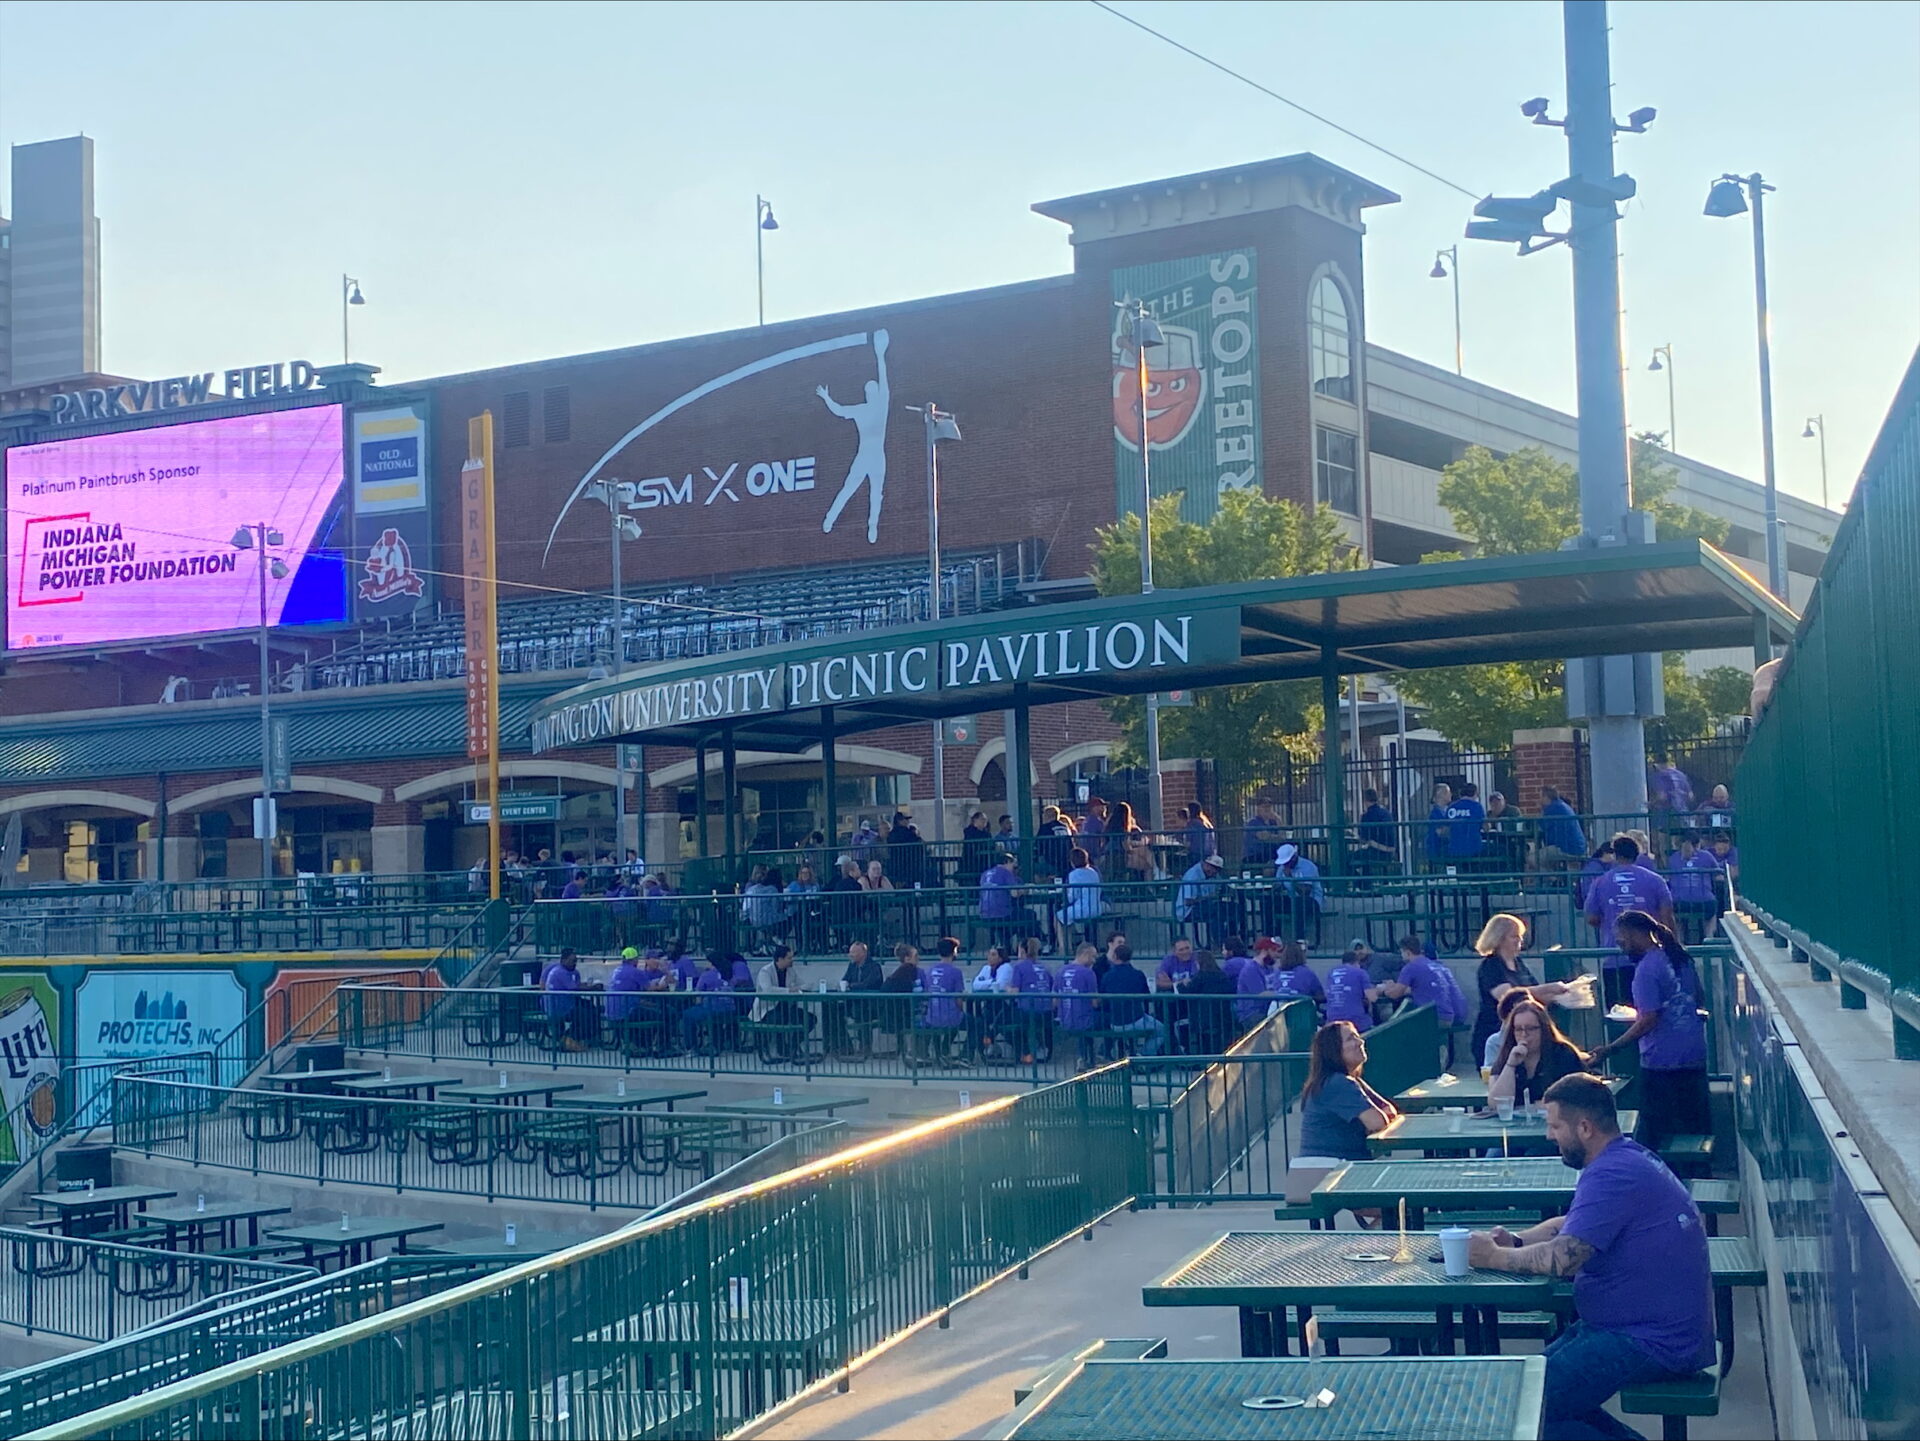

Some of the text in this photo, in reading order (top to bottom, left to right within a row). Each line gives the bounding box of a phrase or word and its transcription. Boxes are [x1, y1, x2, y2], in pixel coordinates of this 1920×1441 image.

[1147, 287, 1194, 315] THE
[51, 359, 316, 424] PARKVIEW FIELD
[365, 458, 415, 472] NATIONAL
[379, 449, 400, 460] OLD
[22, 465, 201, 497] Platinum Paintbrush Sponsor
[702, 462, 740, 505] X
[746, 456, 816, 497] ONE
[42, 523, 123, 548] INDIANA
[41, 542, 136, 570] MICHIGAN
[468, 478, 483, 652] GRABER
[38, 552, 236, 591] POWER FOUNDATION
[531, 616, 1192, 756] HUNTINGTON UNIVERSITY PICNIC PAVILION
[502, 806, 547, 816] EVENT CENTER
[0, 1018, 48, 1078] Lite
[98, 1021, 193, 1048] PROTECHS,
